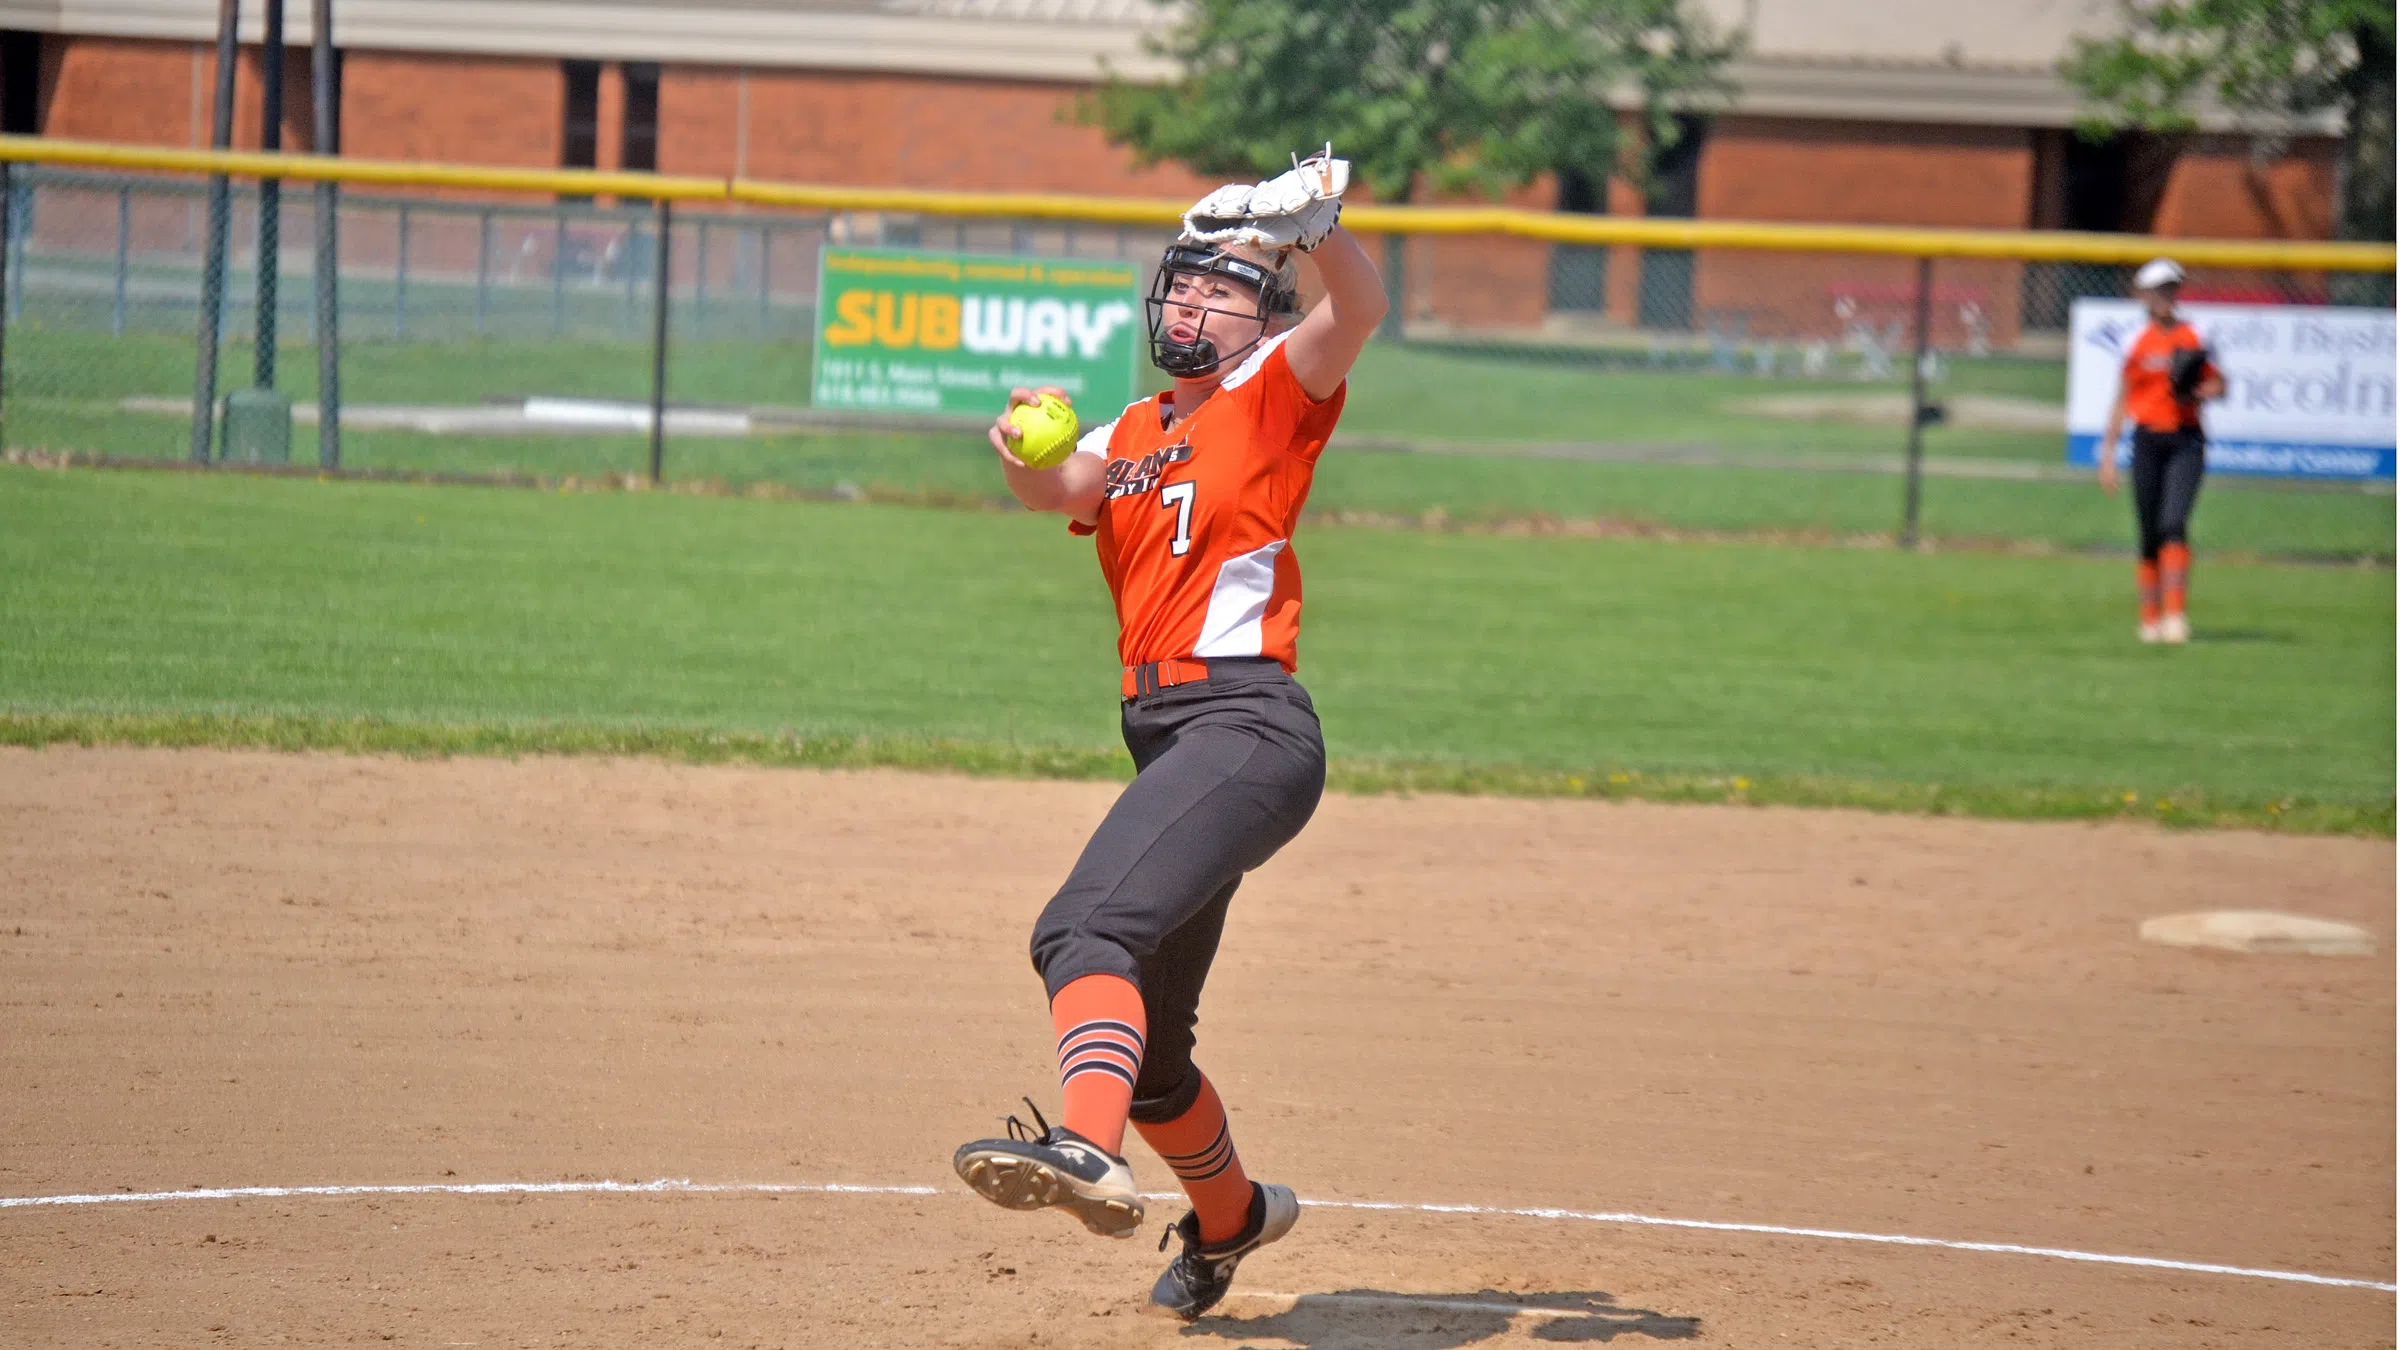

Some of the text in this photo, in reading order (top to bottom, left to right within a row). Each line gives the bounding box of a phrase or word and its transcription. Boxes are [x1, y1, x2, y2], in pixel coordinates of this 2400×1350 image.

[824, 288, 1132, 357] SUBWAY
[2229, 358, 2396, 416] ncoln
[1161, 480, 1196, 558] 7
